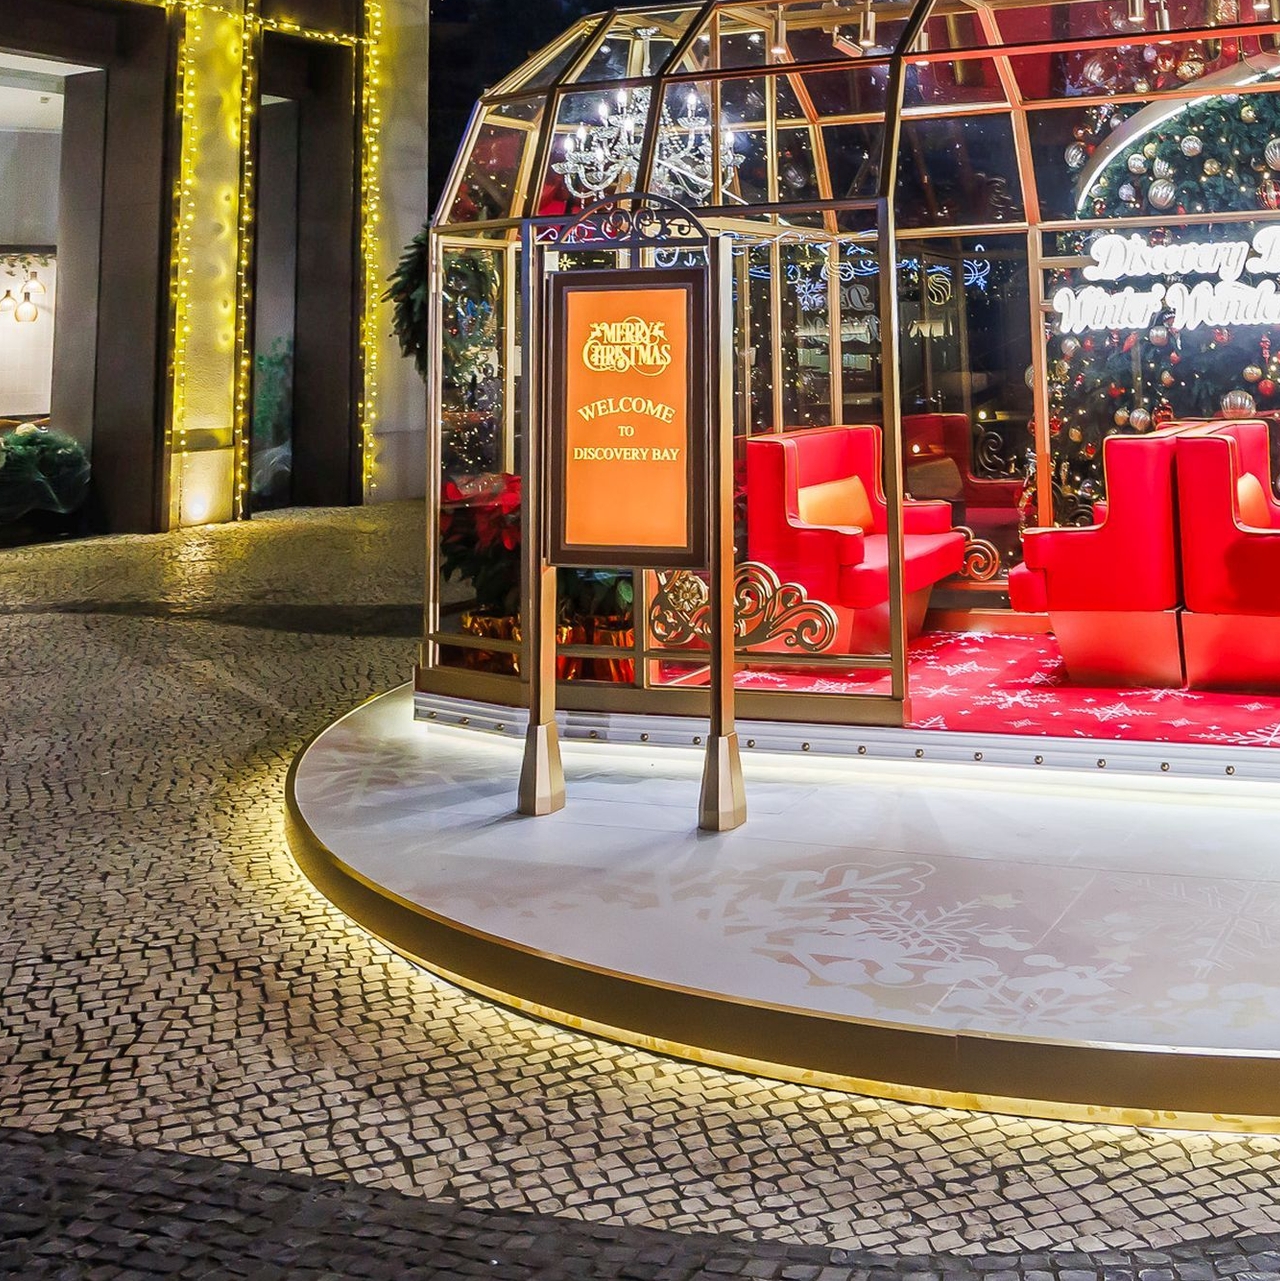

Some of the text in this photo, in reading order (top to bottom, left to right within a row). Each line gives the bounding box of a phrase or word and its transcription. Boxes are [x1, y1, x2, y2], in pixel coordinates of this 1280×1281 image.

[1083, 234, 1250, 281] Discovery
[1053, 283, 1166, 334] Winter
[600, 317, 658, 345] MERRY
[582, 340, 672, 375] CHRISTMAS
[577, 397, 676, 424] WELCOME
[618, 425, 635, 437] TO
[573, 447, 680, 461] DISCOVERY BAY
